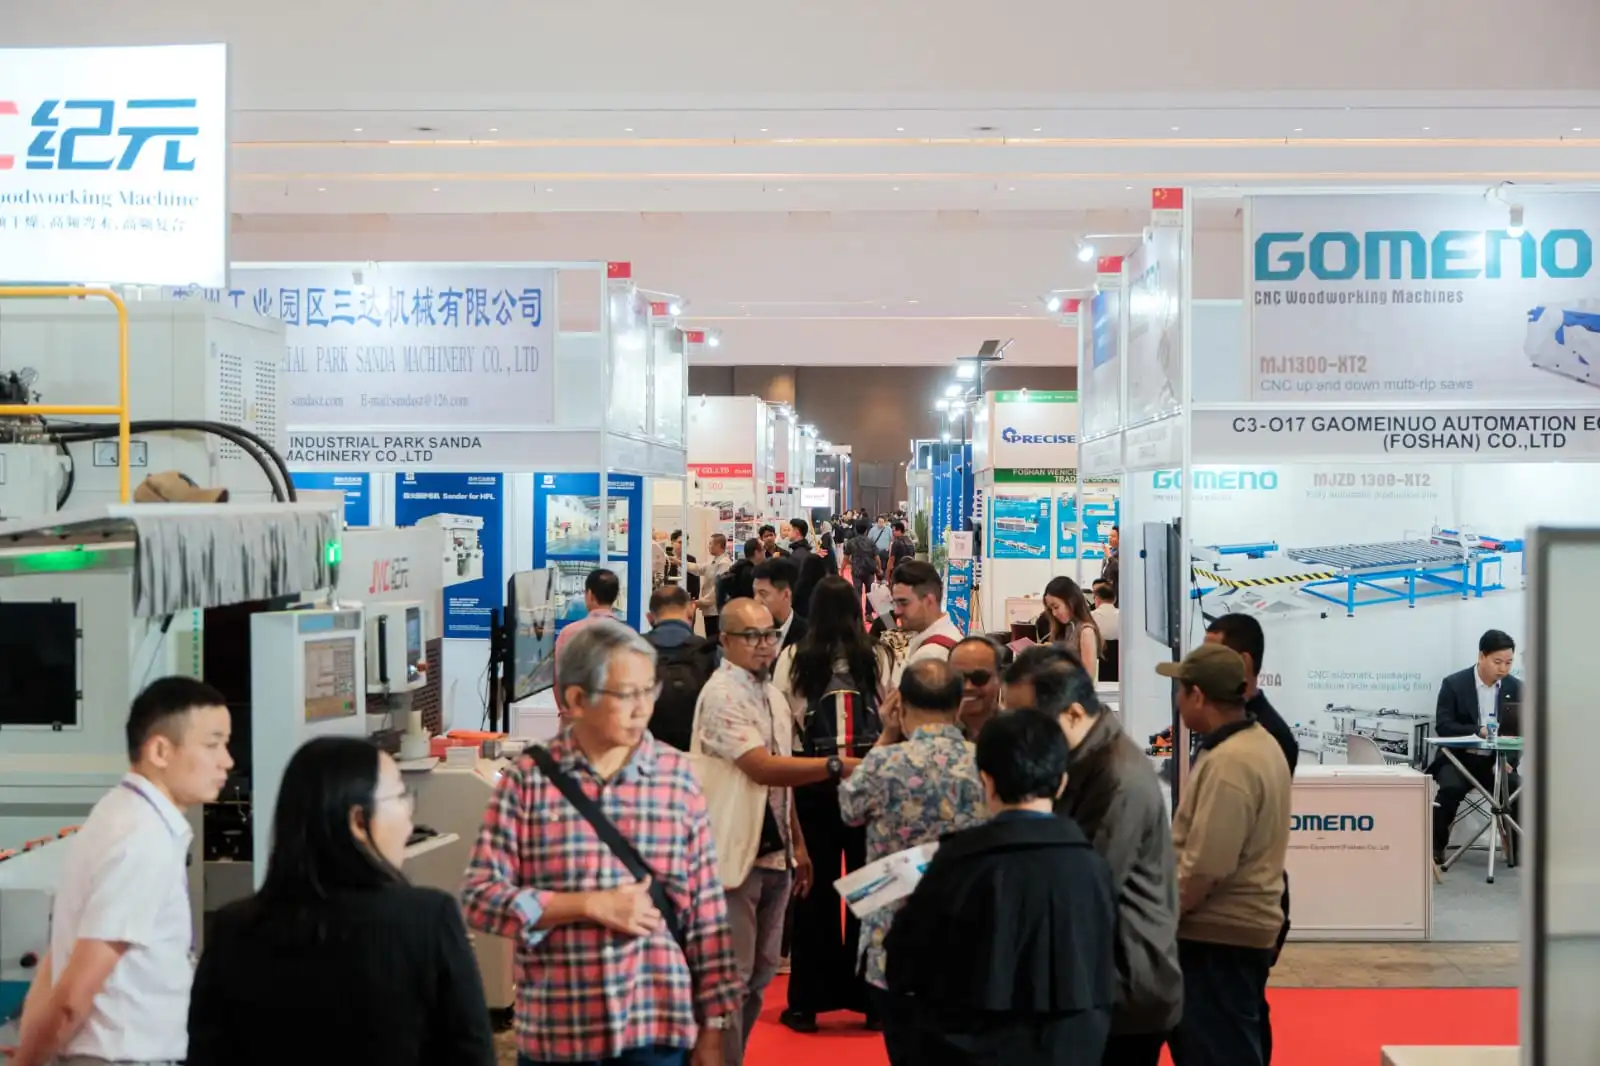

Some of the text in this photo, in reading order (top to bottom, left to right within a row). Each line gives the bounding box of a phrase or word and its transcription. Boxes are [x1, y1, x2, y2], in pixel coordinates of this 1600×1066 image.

[26, 98, 199, 171] 纪元
[119, 190, 199, 207] Machine
[1255, 229, 1592, 281] GOMENO
[1255, 289, 1464, 306] CNC Woodworking Machines
[316, 346, 348, 372] PARK
[356, 346, 396, 372] SANDA
[403, 345, 474, 372] MACHINERY
[1260, 356, 1367, 374] MJ1300-XT2
[1261, 380, 1292, 391] CNC
[1297, 381, 1312, 392] up
[1316, 379, 1341, 391] and
[1345, 379, 1379, 391] down
[1440, 380, 1473, 390] saws
[1312, 416, 1437, 432] GAOMEINUO
[1442, 415, 1577, 431] AUTOMATION
[290, 436, 482, 449] INDUSTRIAL PARK SANDA
[1384, 433, 1566, 451] (FOSHAN) CO.,LTD
